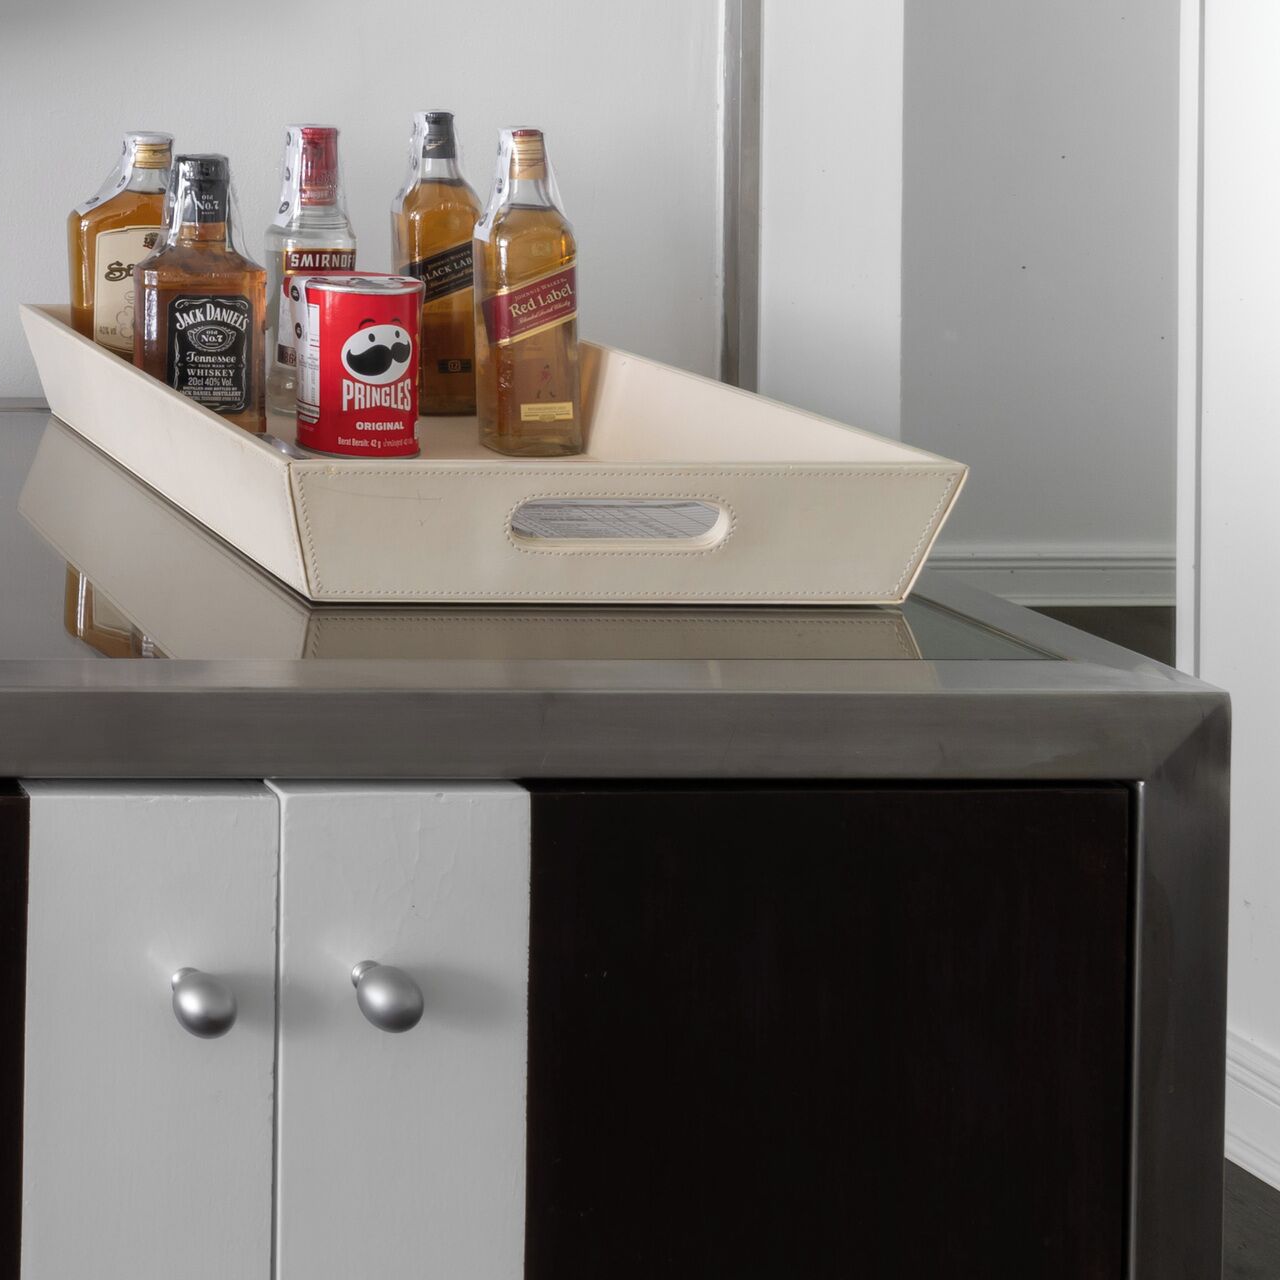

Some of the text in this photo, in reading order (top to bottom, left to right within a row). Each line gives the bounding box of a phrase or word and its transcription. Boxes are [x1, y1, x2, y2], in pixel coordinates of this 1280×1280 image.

[420, 264, 452, 281] BLACK
[453, 256, 473, 270] LAB
[509, 283, 573, 318] Red Label
[175, 307, 206, 331] JACK
[186, 351, 237, 363] Tennessee
[186, 368, 236, 377] WHISKEY
[188, 377, 233, 386] 20cl 40% Vol.
[342, 378, 412, 412] PRINGLES
[355, 421, 404, 431] ORIGINAL
